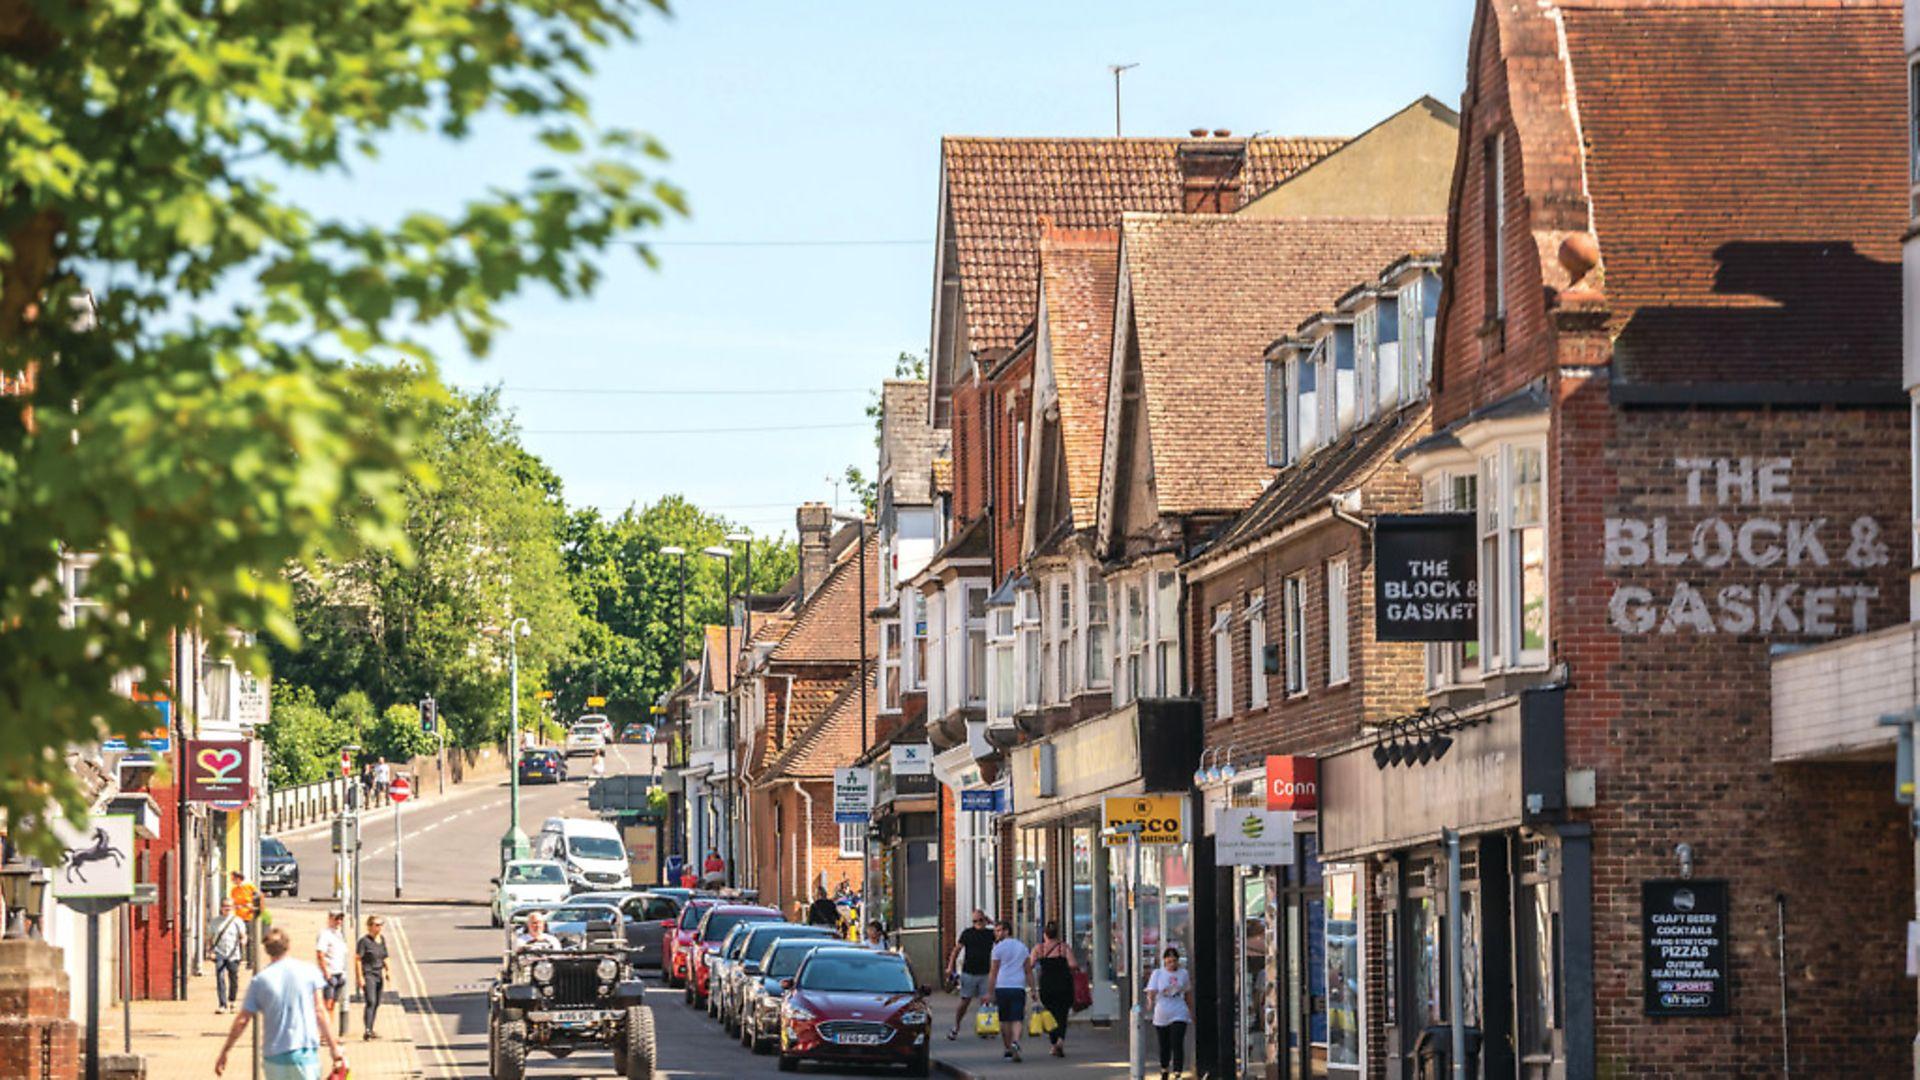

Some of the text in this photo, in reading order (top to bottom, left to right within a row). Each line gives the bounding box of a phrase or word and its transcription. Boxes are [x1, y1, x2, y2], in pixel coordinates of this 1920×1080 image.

[1675, 457, 1792, 506] THE
[1604, 515, 1890, 568] BLOCK &
[1408, 560, 1448, 577] THE
[1384, 580, 1478, 598] BLOCK &
[1386, 602, 1476, 620] GASKET
[1608, 581, 1880, 635] GASKET
[1109, 819, 1178, 833] DSCO
[1651, 914, 1685, 923] CRAFT
[1656, 926, 1713, 935] COCKTAILS
[1661, 946, 1709, 958] PIZZAS
[1693, 969, 1720, 978] AREA
